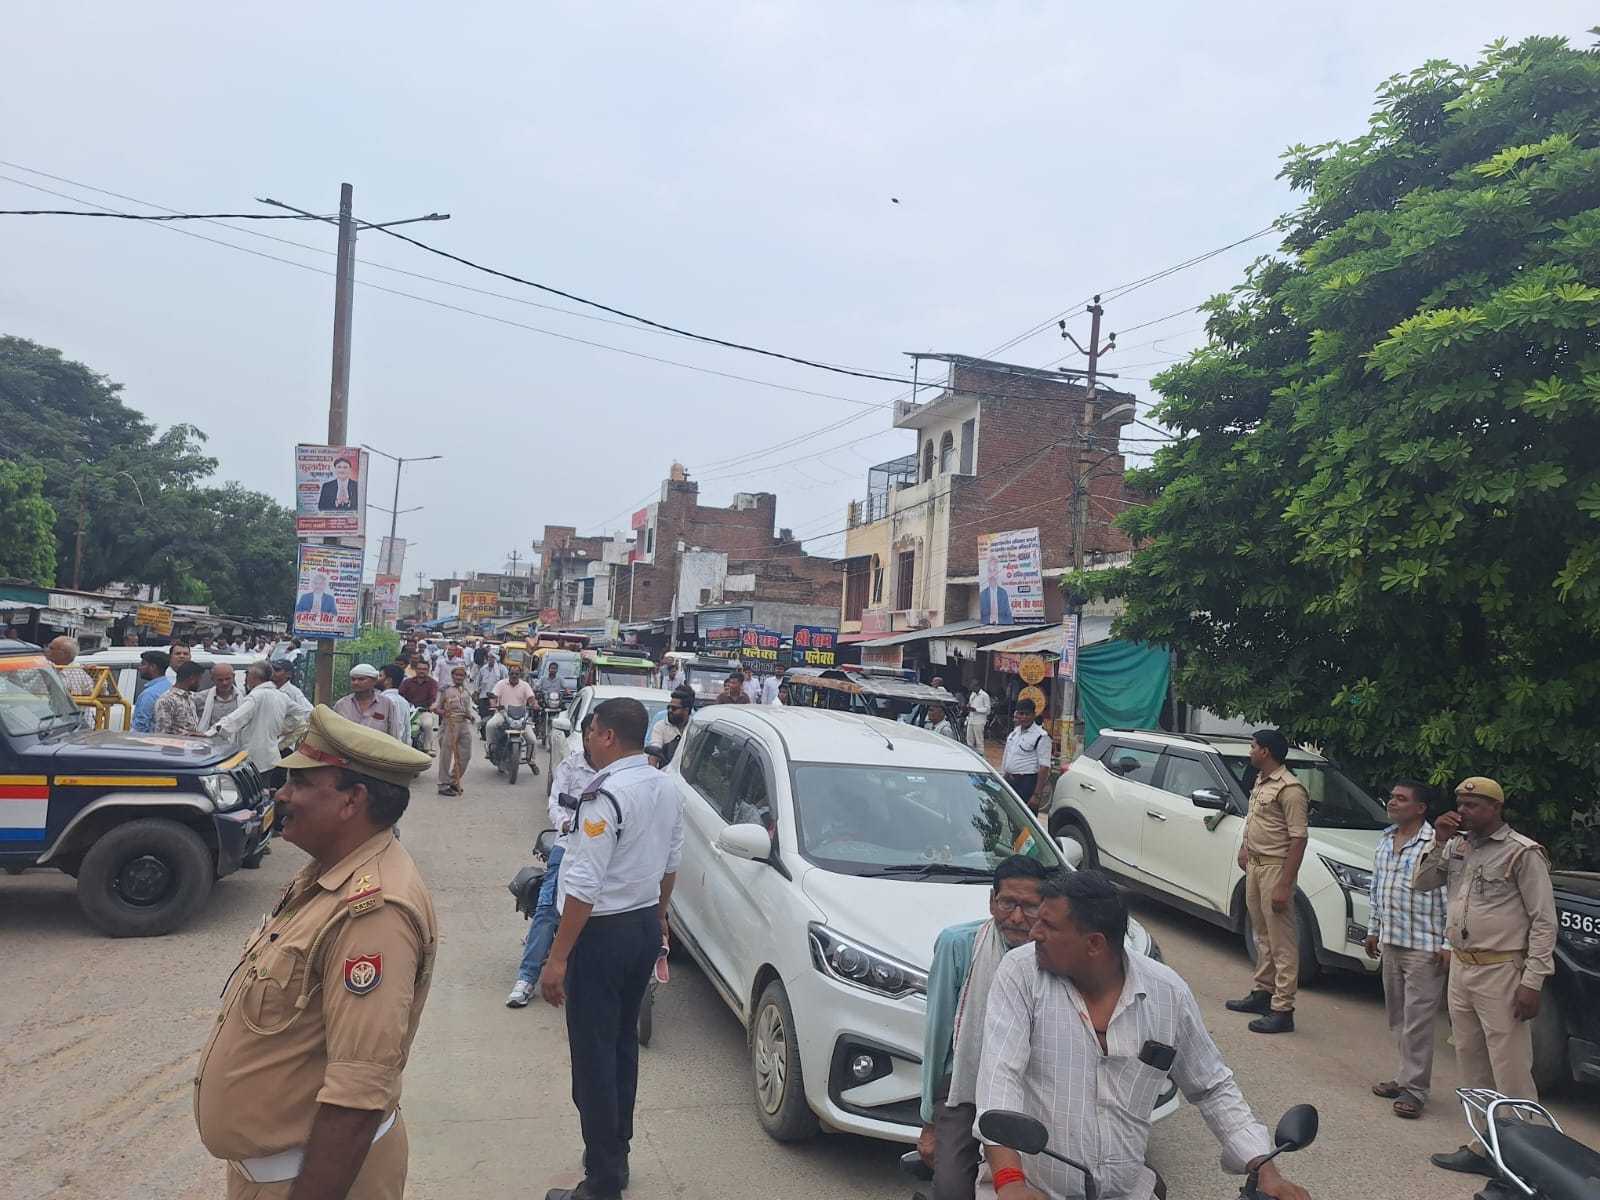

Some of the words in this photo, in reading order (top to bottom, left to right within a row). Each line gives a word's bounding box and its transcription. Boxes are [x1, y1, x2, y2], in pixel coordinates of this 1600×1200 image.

[743, 629, 758, 645] श्री
[759, 634, 779, 648] राम
[795, 628, 810, 646] श्री
[812, 633, 832, 648] राम
[1560, 911, 1600, 935] 5363
